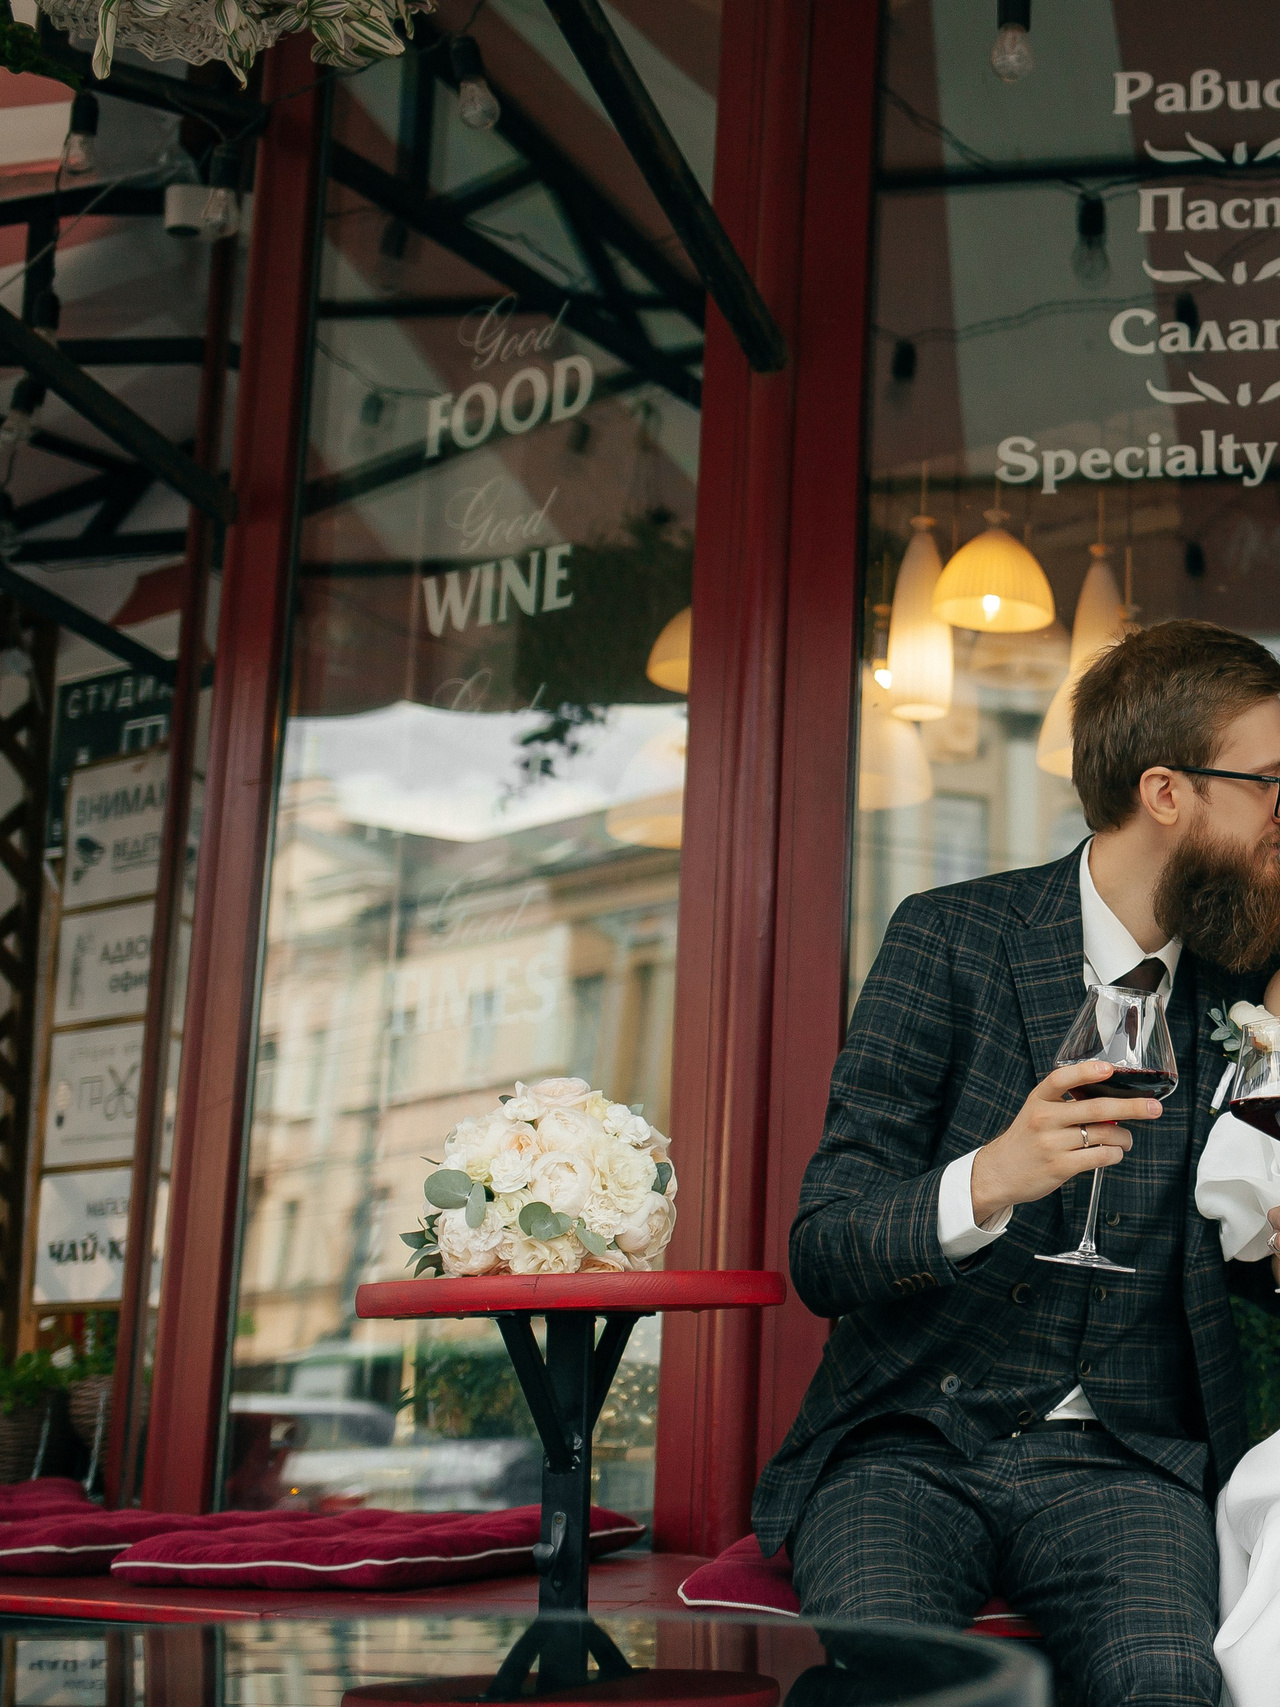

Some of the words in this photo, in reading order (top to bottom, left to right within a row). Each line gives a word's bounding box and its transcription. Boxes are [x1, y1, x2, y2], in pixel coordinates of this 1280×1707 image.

[457, 294, 569, 371] Good
[425, 354, 594, 459] FOOD
[995, 429, 1278, 494] Specialty
[445, 480, 559, 554] Good
[422, 543, 575, 638] WINE
[75, 780, 167, 827] ВНИМА
[100, 935, 150, 964] АДВО
